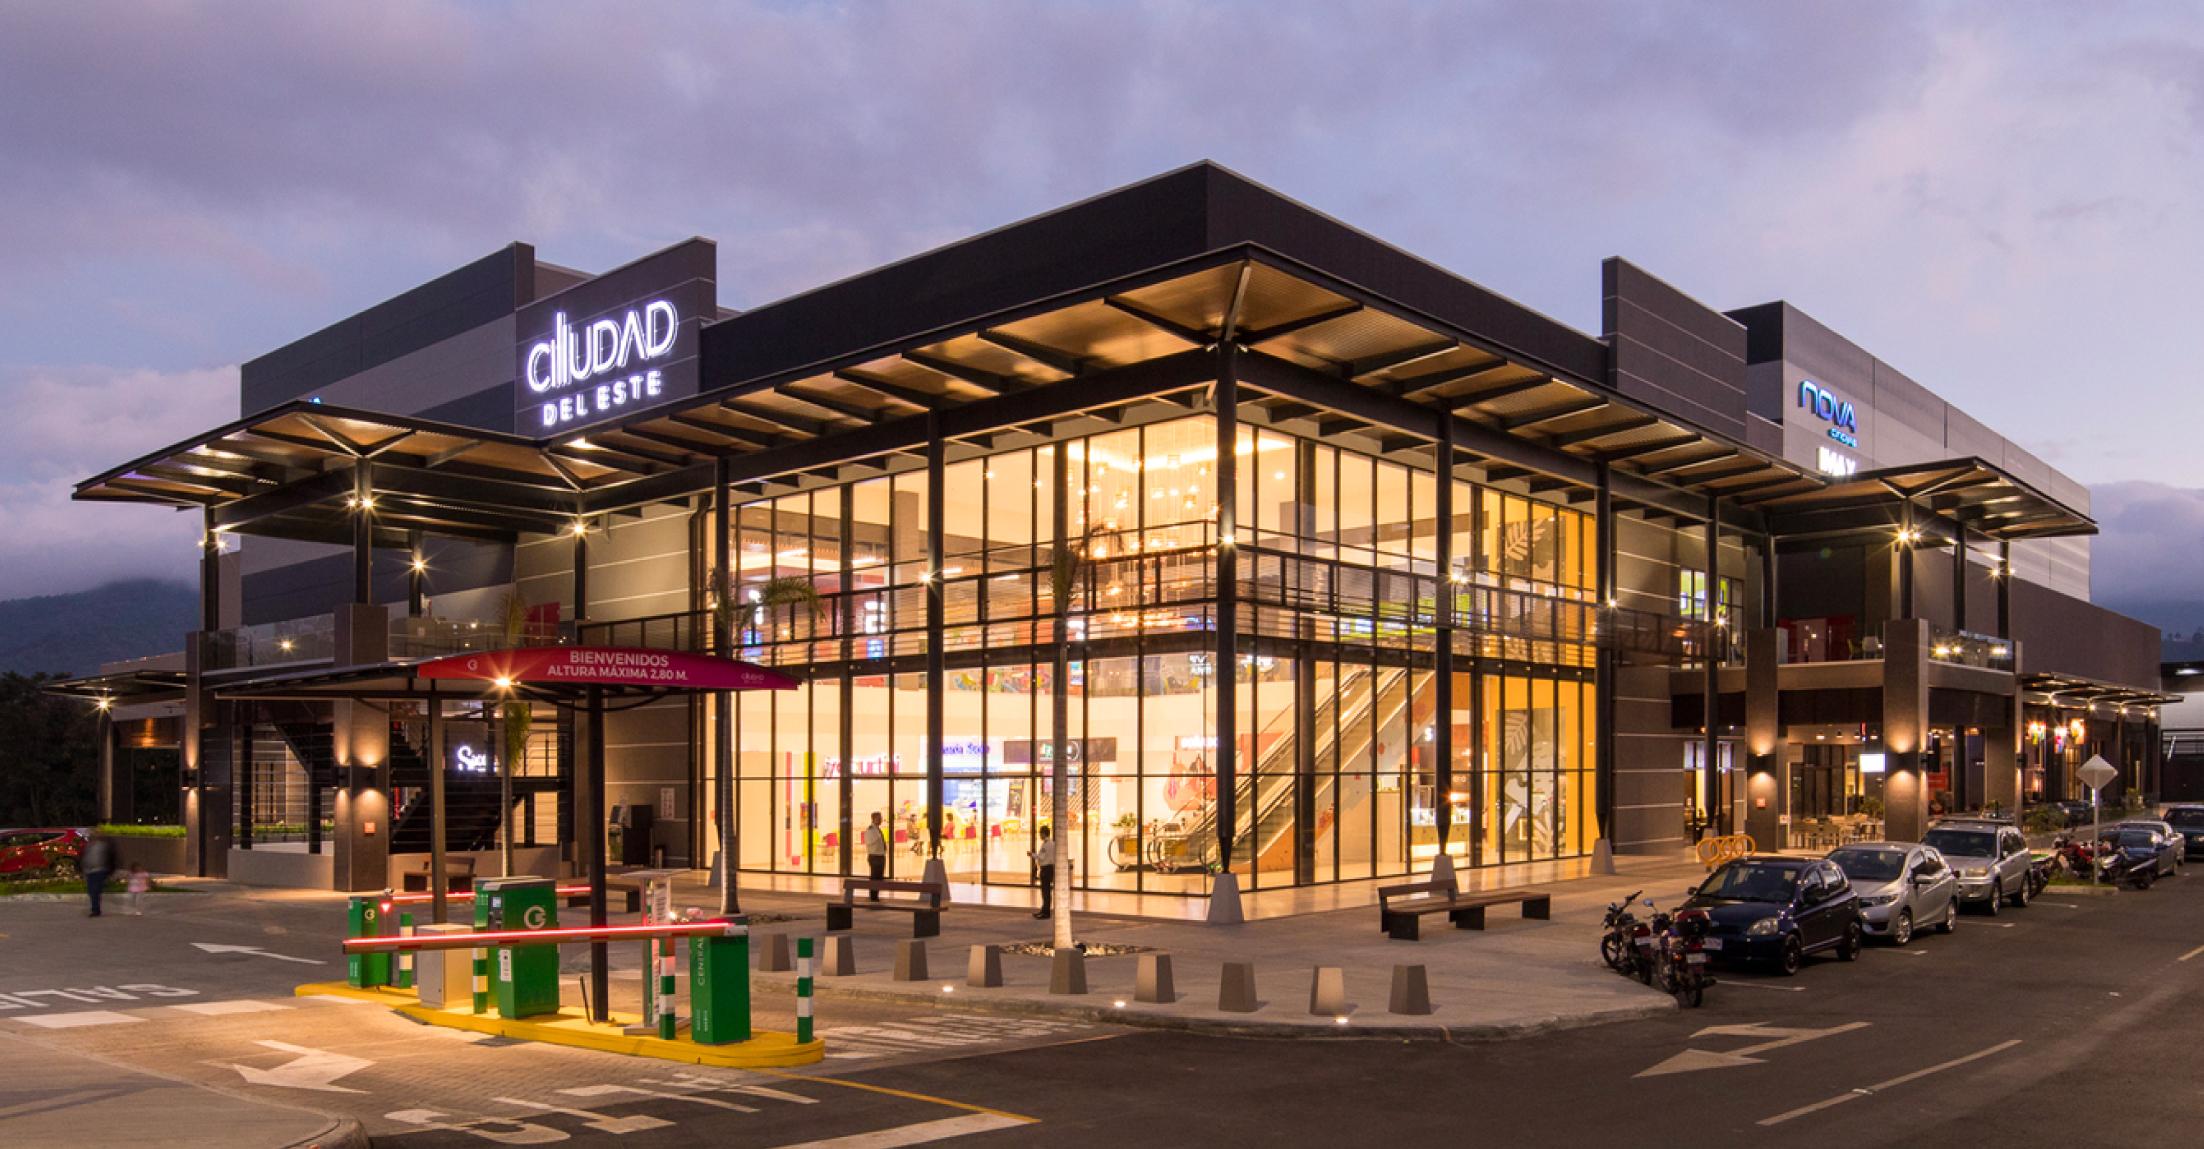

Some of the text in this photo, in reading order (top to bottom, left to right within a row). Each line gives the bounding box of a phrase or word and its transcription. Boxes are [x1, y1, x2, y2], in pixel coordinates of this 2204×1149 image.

[543, 370, 662, 427] DEL ESTE
[569, 650, 669, 667] BIENVENIDOS
[547, 664, 597, 677] ALTURA
[599, 664, 648, 679] MÁXIMA
